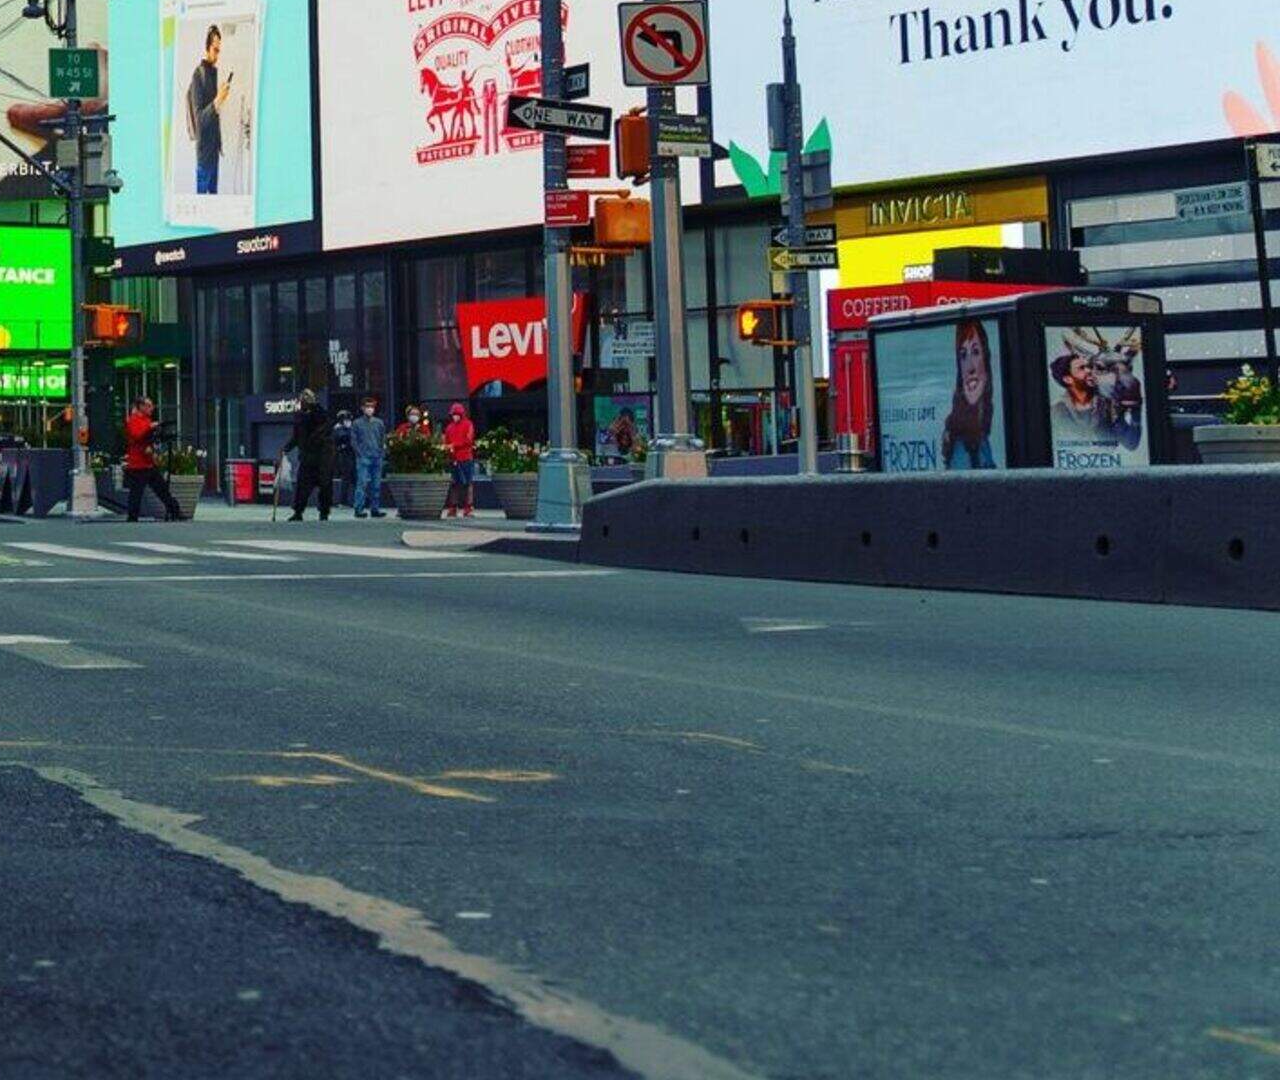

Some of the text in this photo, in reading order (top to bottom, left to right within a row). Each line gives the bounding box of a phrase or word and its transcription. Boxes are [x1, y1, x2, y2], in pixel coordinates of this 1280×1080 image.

[416, 17, 488, 53] ORIGINAL
[67, 54, 81, 64] TO
[434, 50, 469, 71] QUALITY
[66, 67, 81, 78] 45
[523, 101, 599, 128] ONE WAY
[870, 190, 972, 227] INVICTA
[903, 265, 932, 281] SHOP
[883, 433, 938, 471] FROZEN
[1056, 449, 1122, 470] FROZEN
